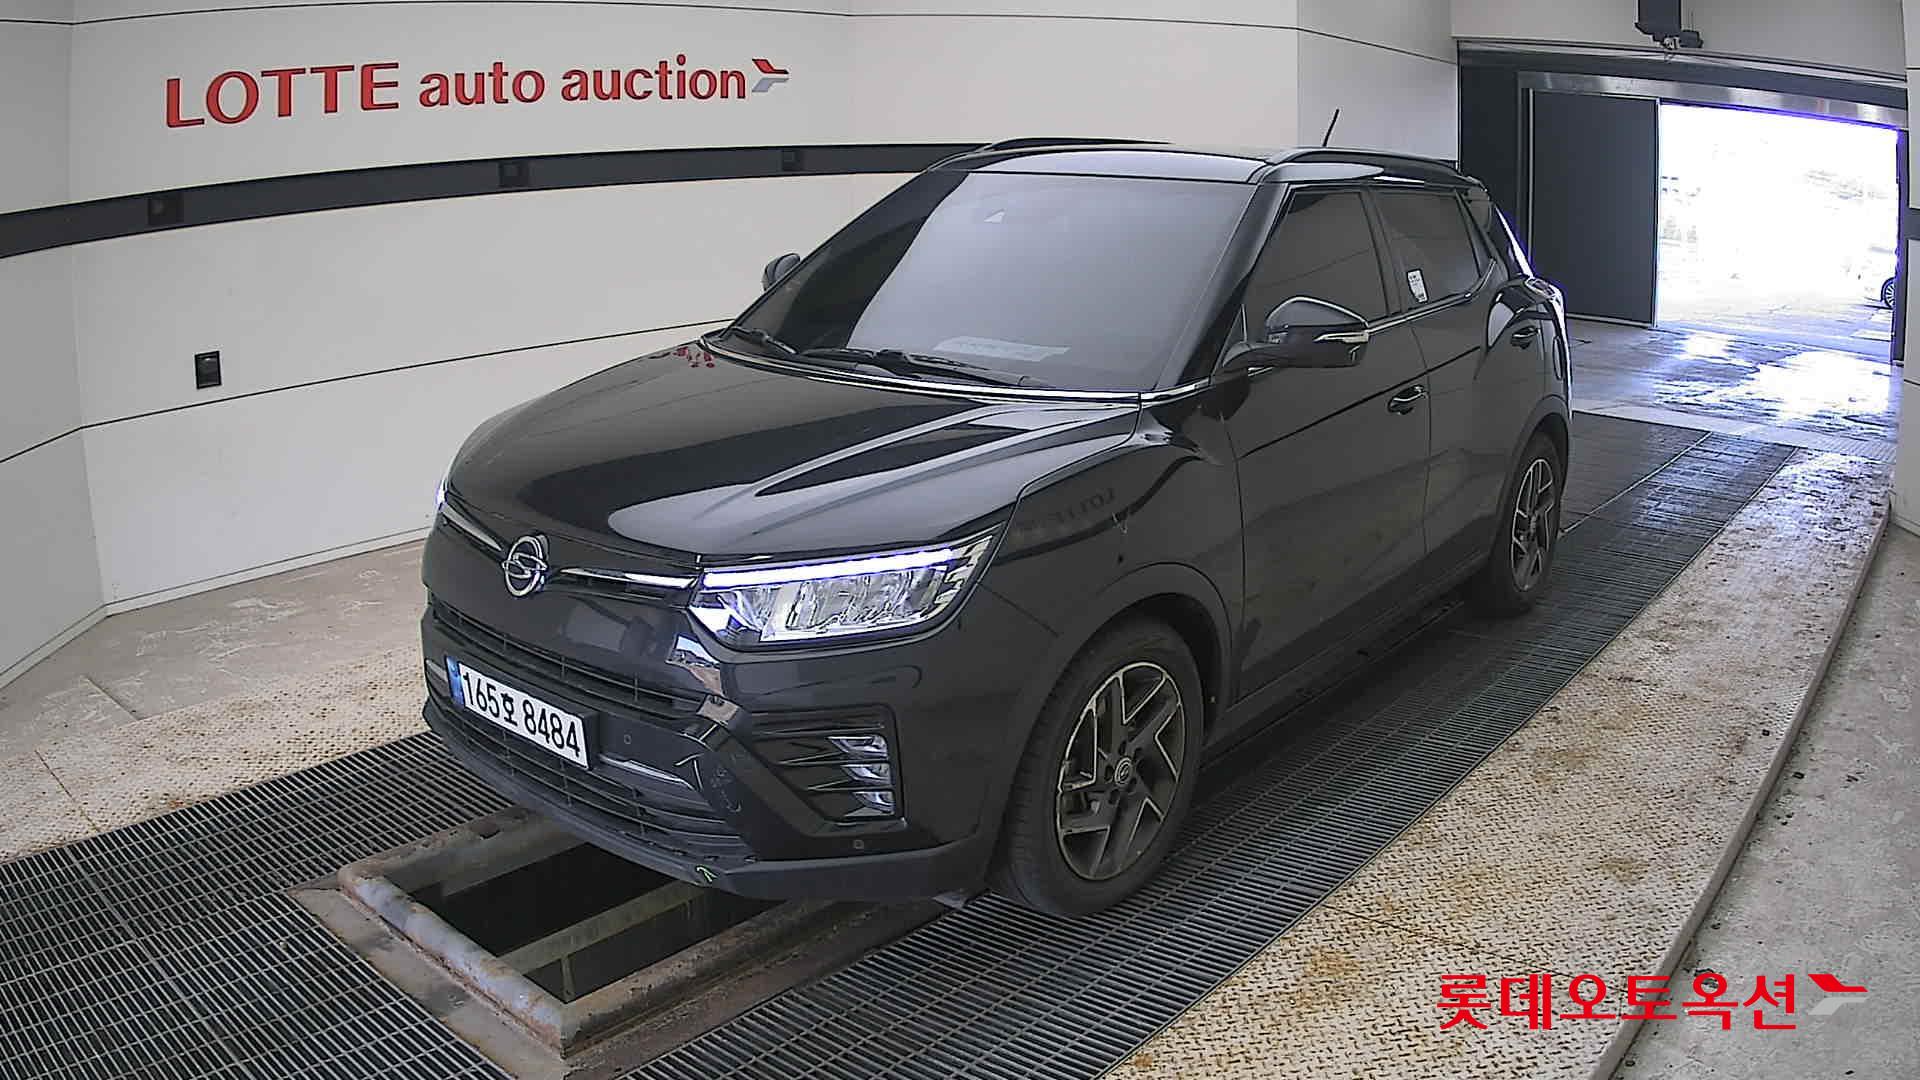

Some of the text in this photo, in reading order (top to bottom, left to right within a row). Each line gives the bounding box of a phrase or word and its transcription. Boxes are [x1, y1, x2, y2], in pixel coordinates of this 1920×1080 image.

[166, 54, 747, 129] LOTTE auto auction
[463, 671, 580, 758] 165호 8484
